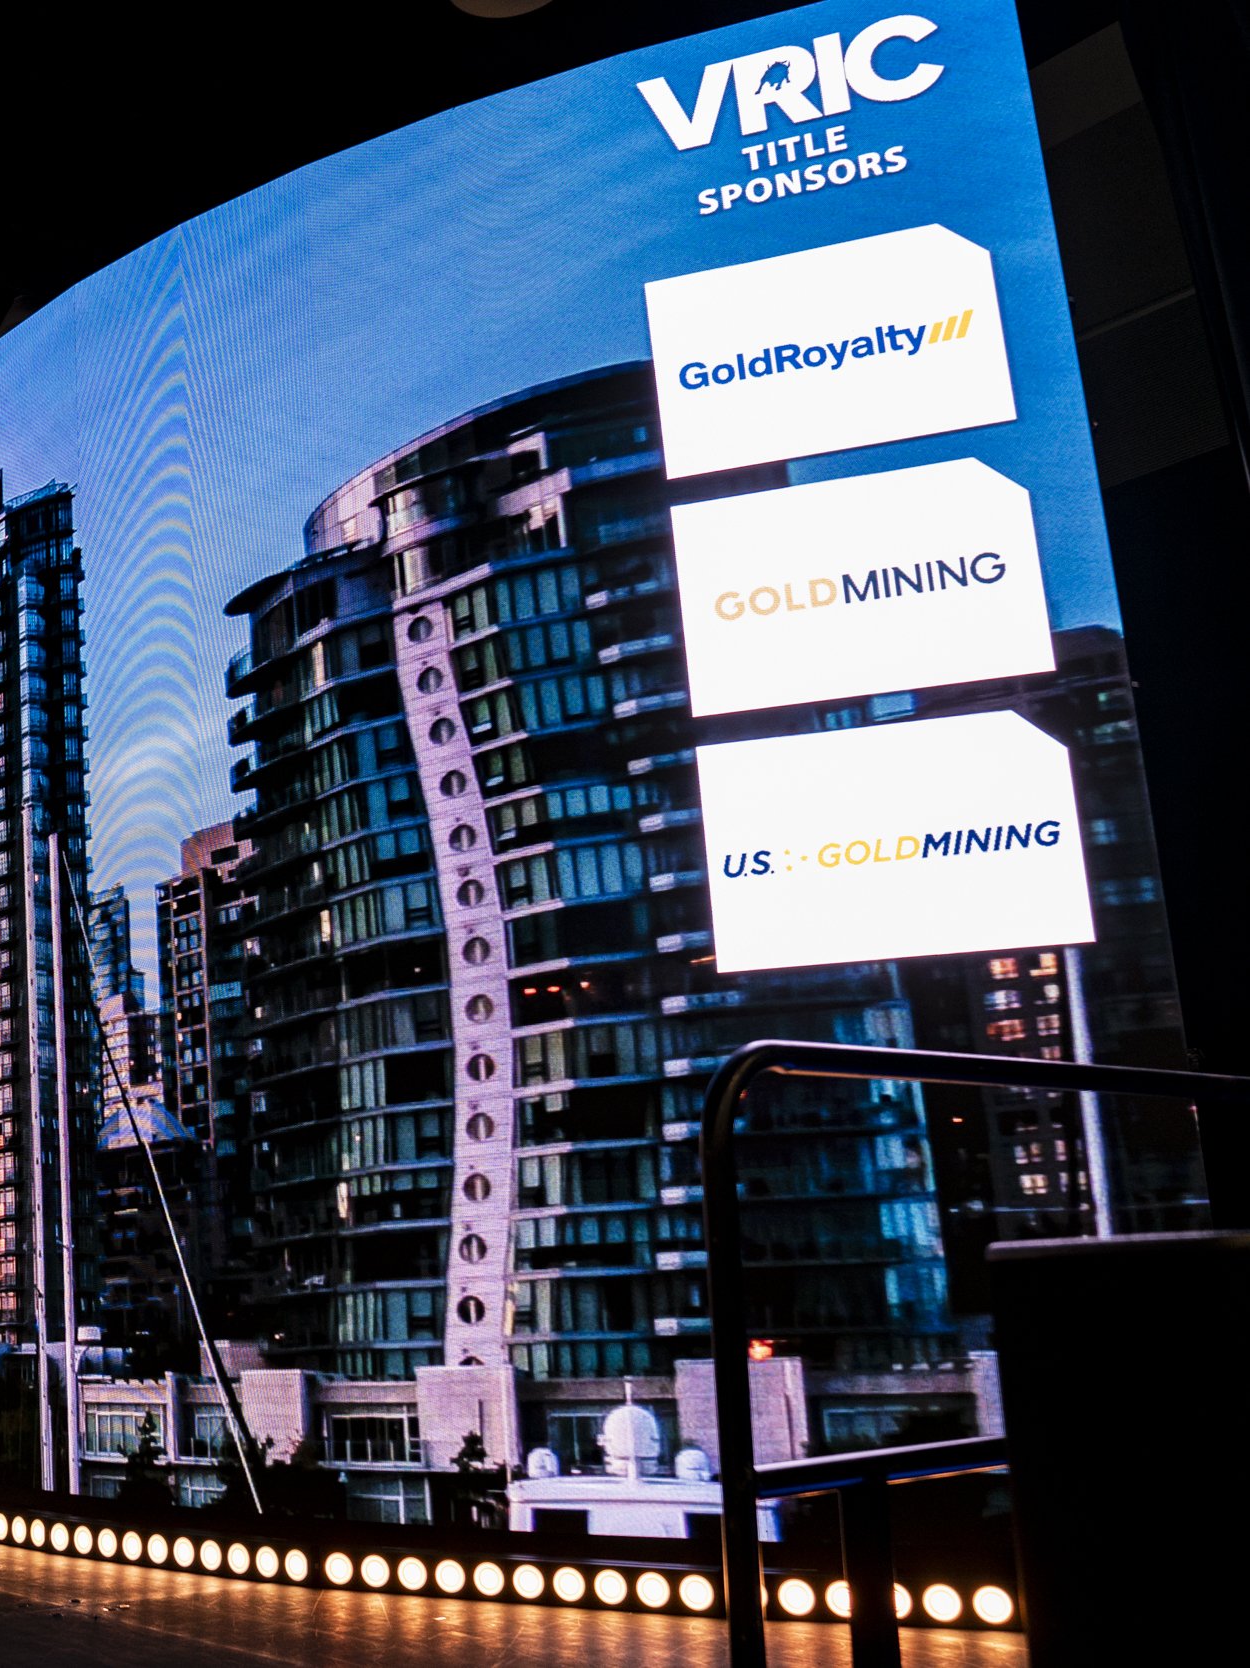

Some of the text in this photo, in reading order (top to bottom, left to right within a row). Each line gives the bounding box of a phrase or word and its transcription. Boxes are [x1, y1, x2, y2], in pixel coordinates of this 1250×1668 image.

[636, 14, 945, 151] VRIC
[698, 145, 908, 215] SPONSORS
[741, 125, 848, 171] TITLE
[678, 324, 927, 390] GoldRoyalty
[714, 552, 1007, 621] GOLDMINING
[723, 820, 1061, 878] U.S. GOLDMINING
